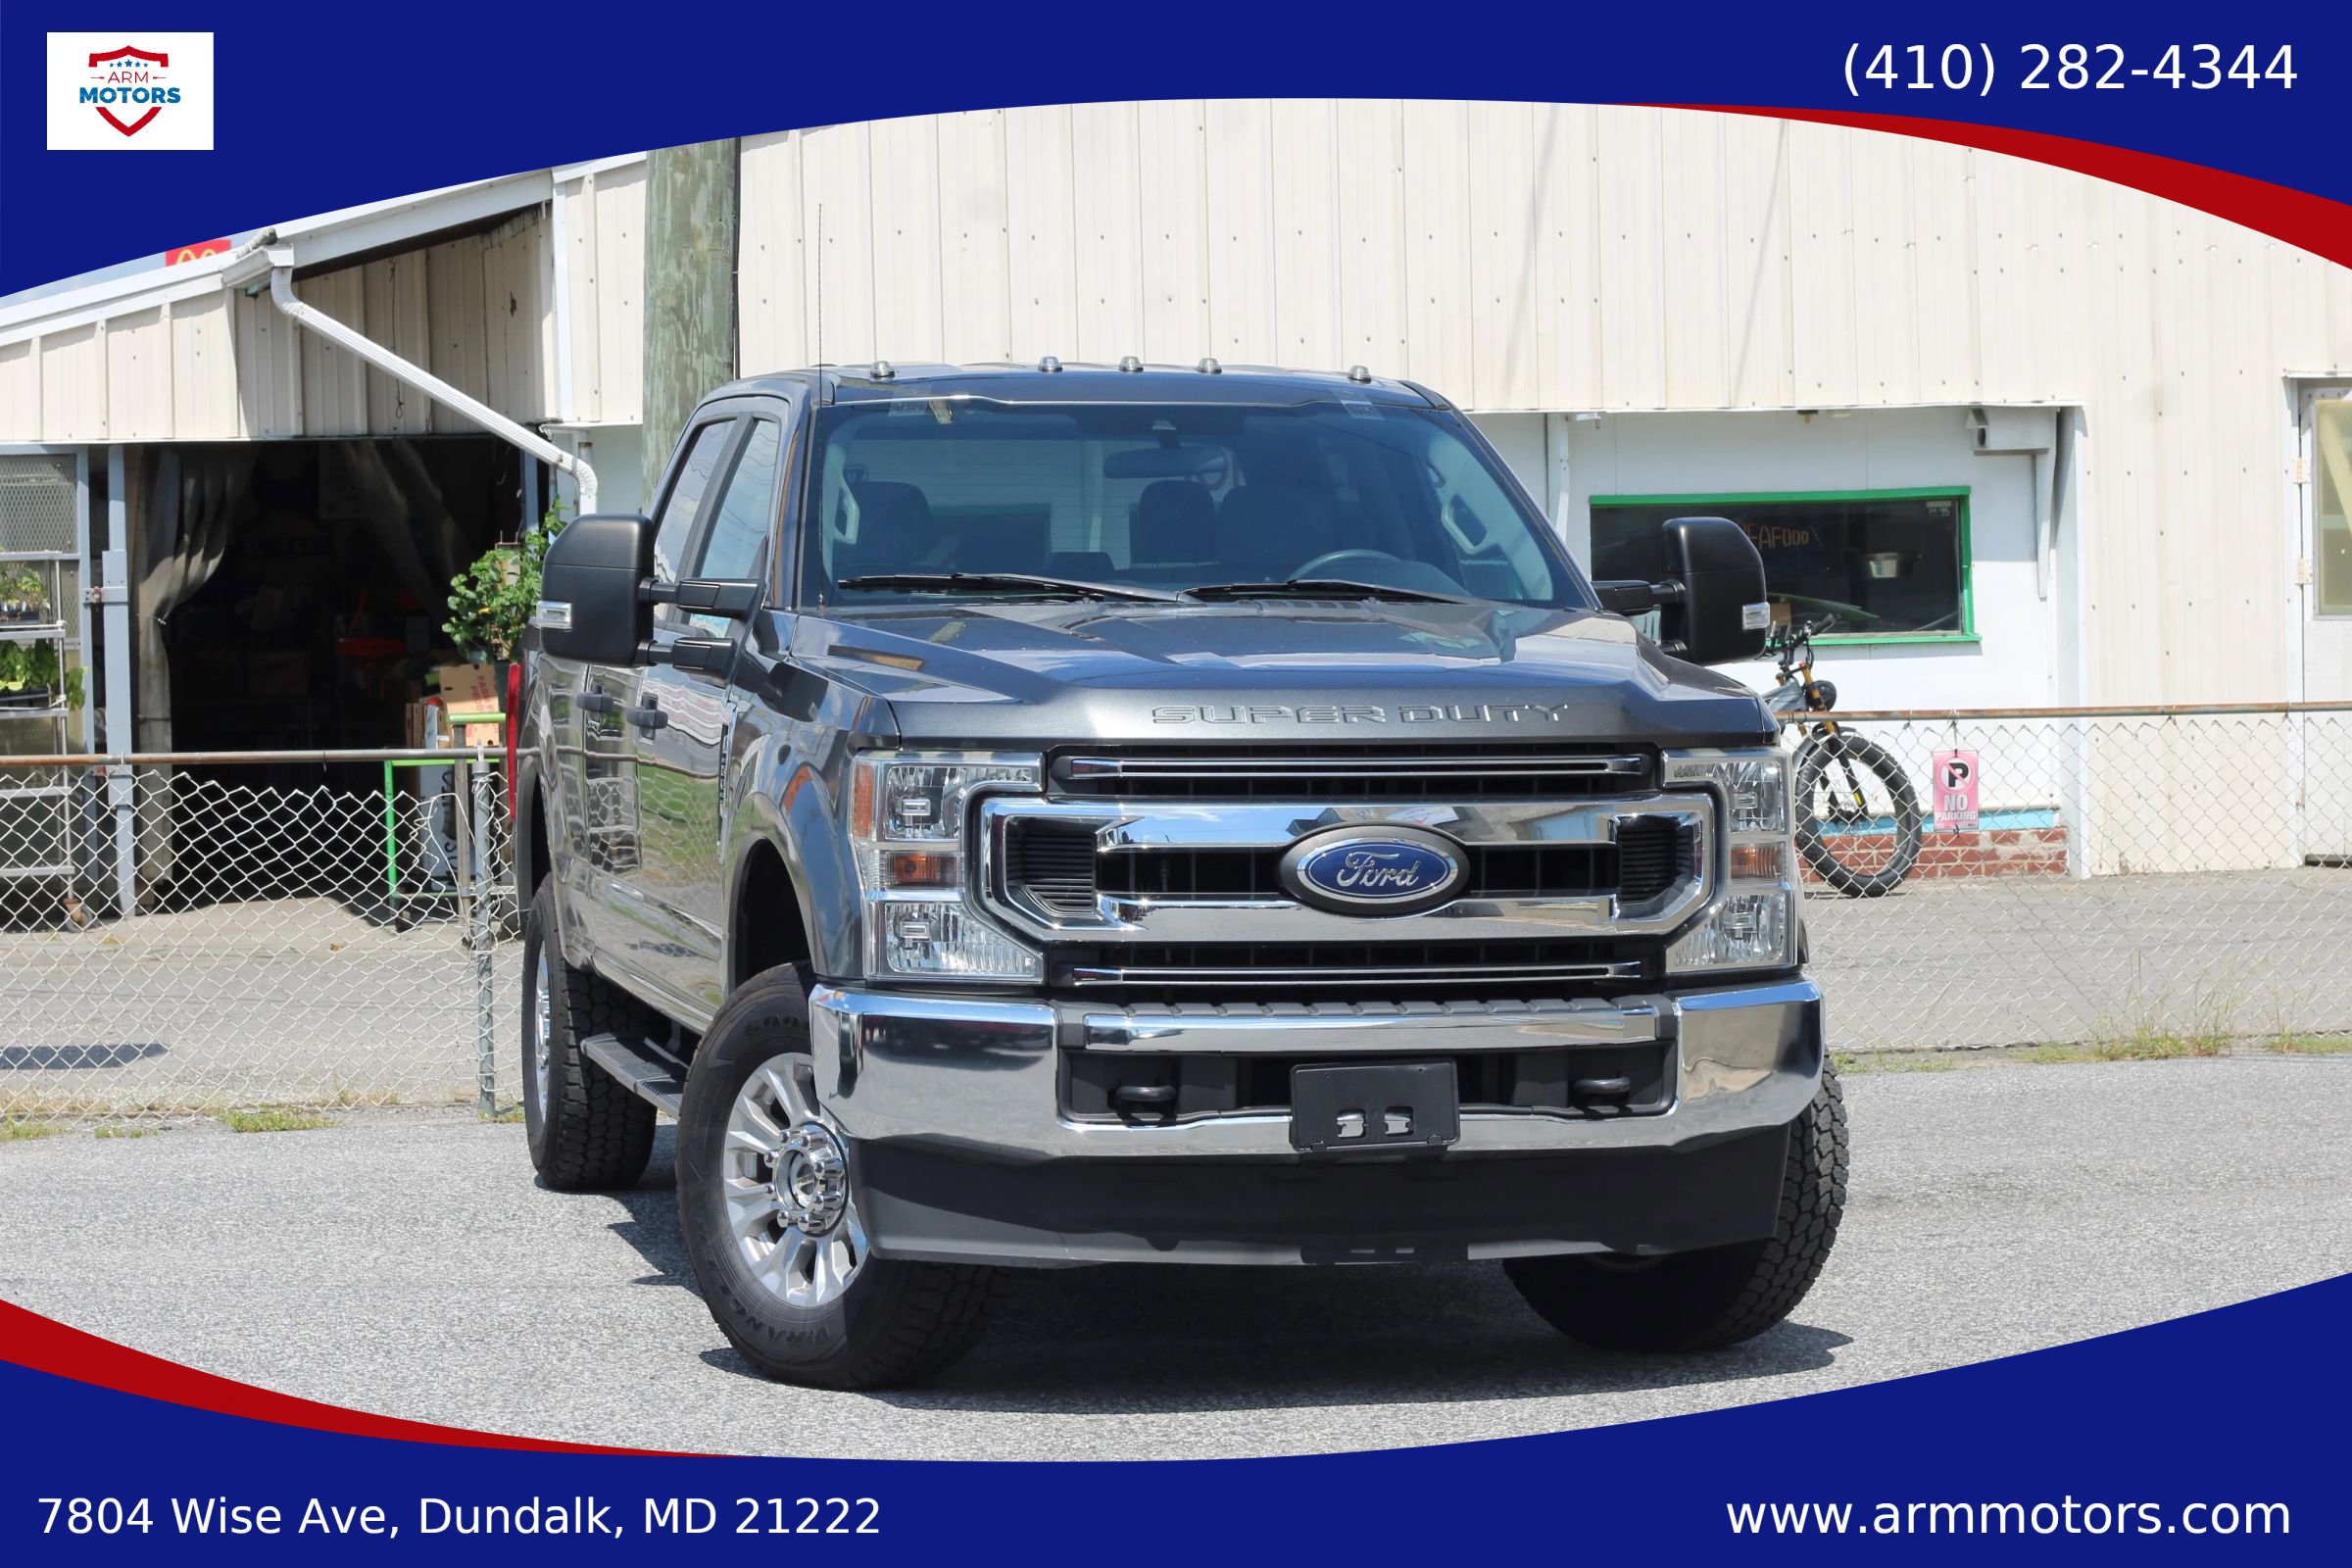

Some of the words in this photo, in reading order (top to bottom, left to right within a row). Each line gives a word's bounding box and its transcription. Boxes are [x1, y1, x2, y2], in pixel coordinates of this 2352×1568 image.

[1743, 522, 1810, 551] EAFOOD
[1152, 705, 1387, 723] SUPER
[1398, 704, 1569, 723] DUTY
[1944, 794, 1968, 811] NO
[1936, 810, 1977, 821] PARKING
[1337, 851, 1421, 887] Ford
